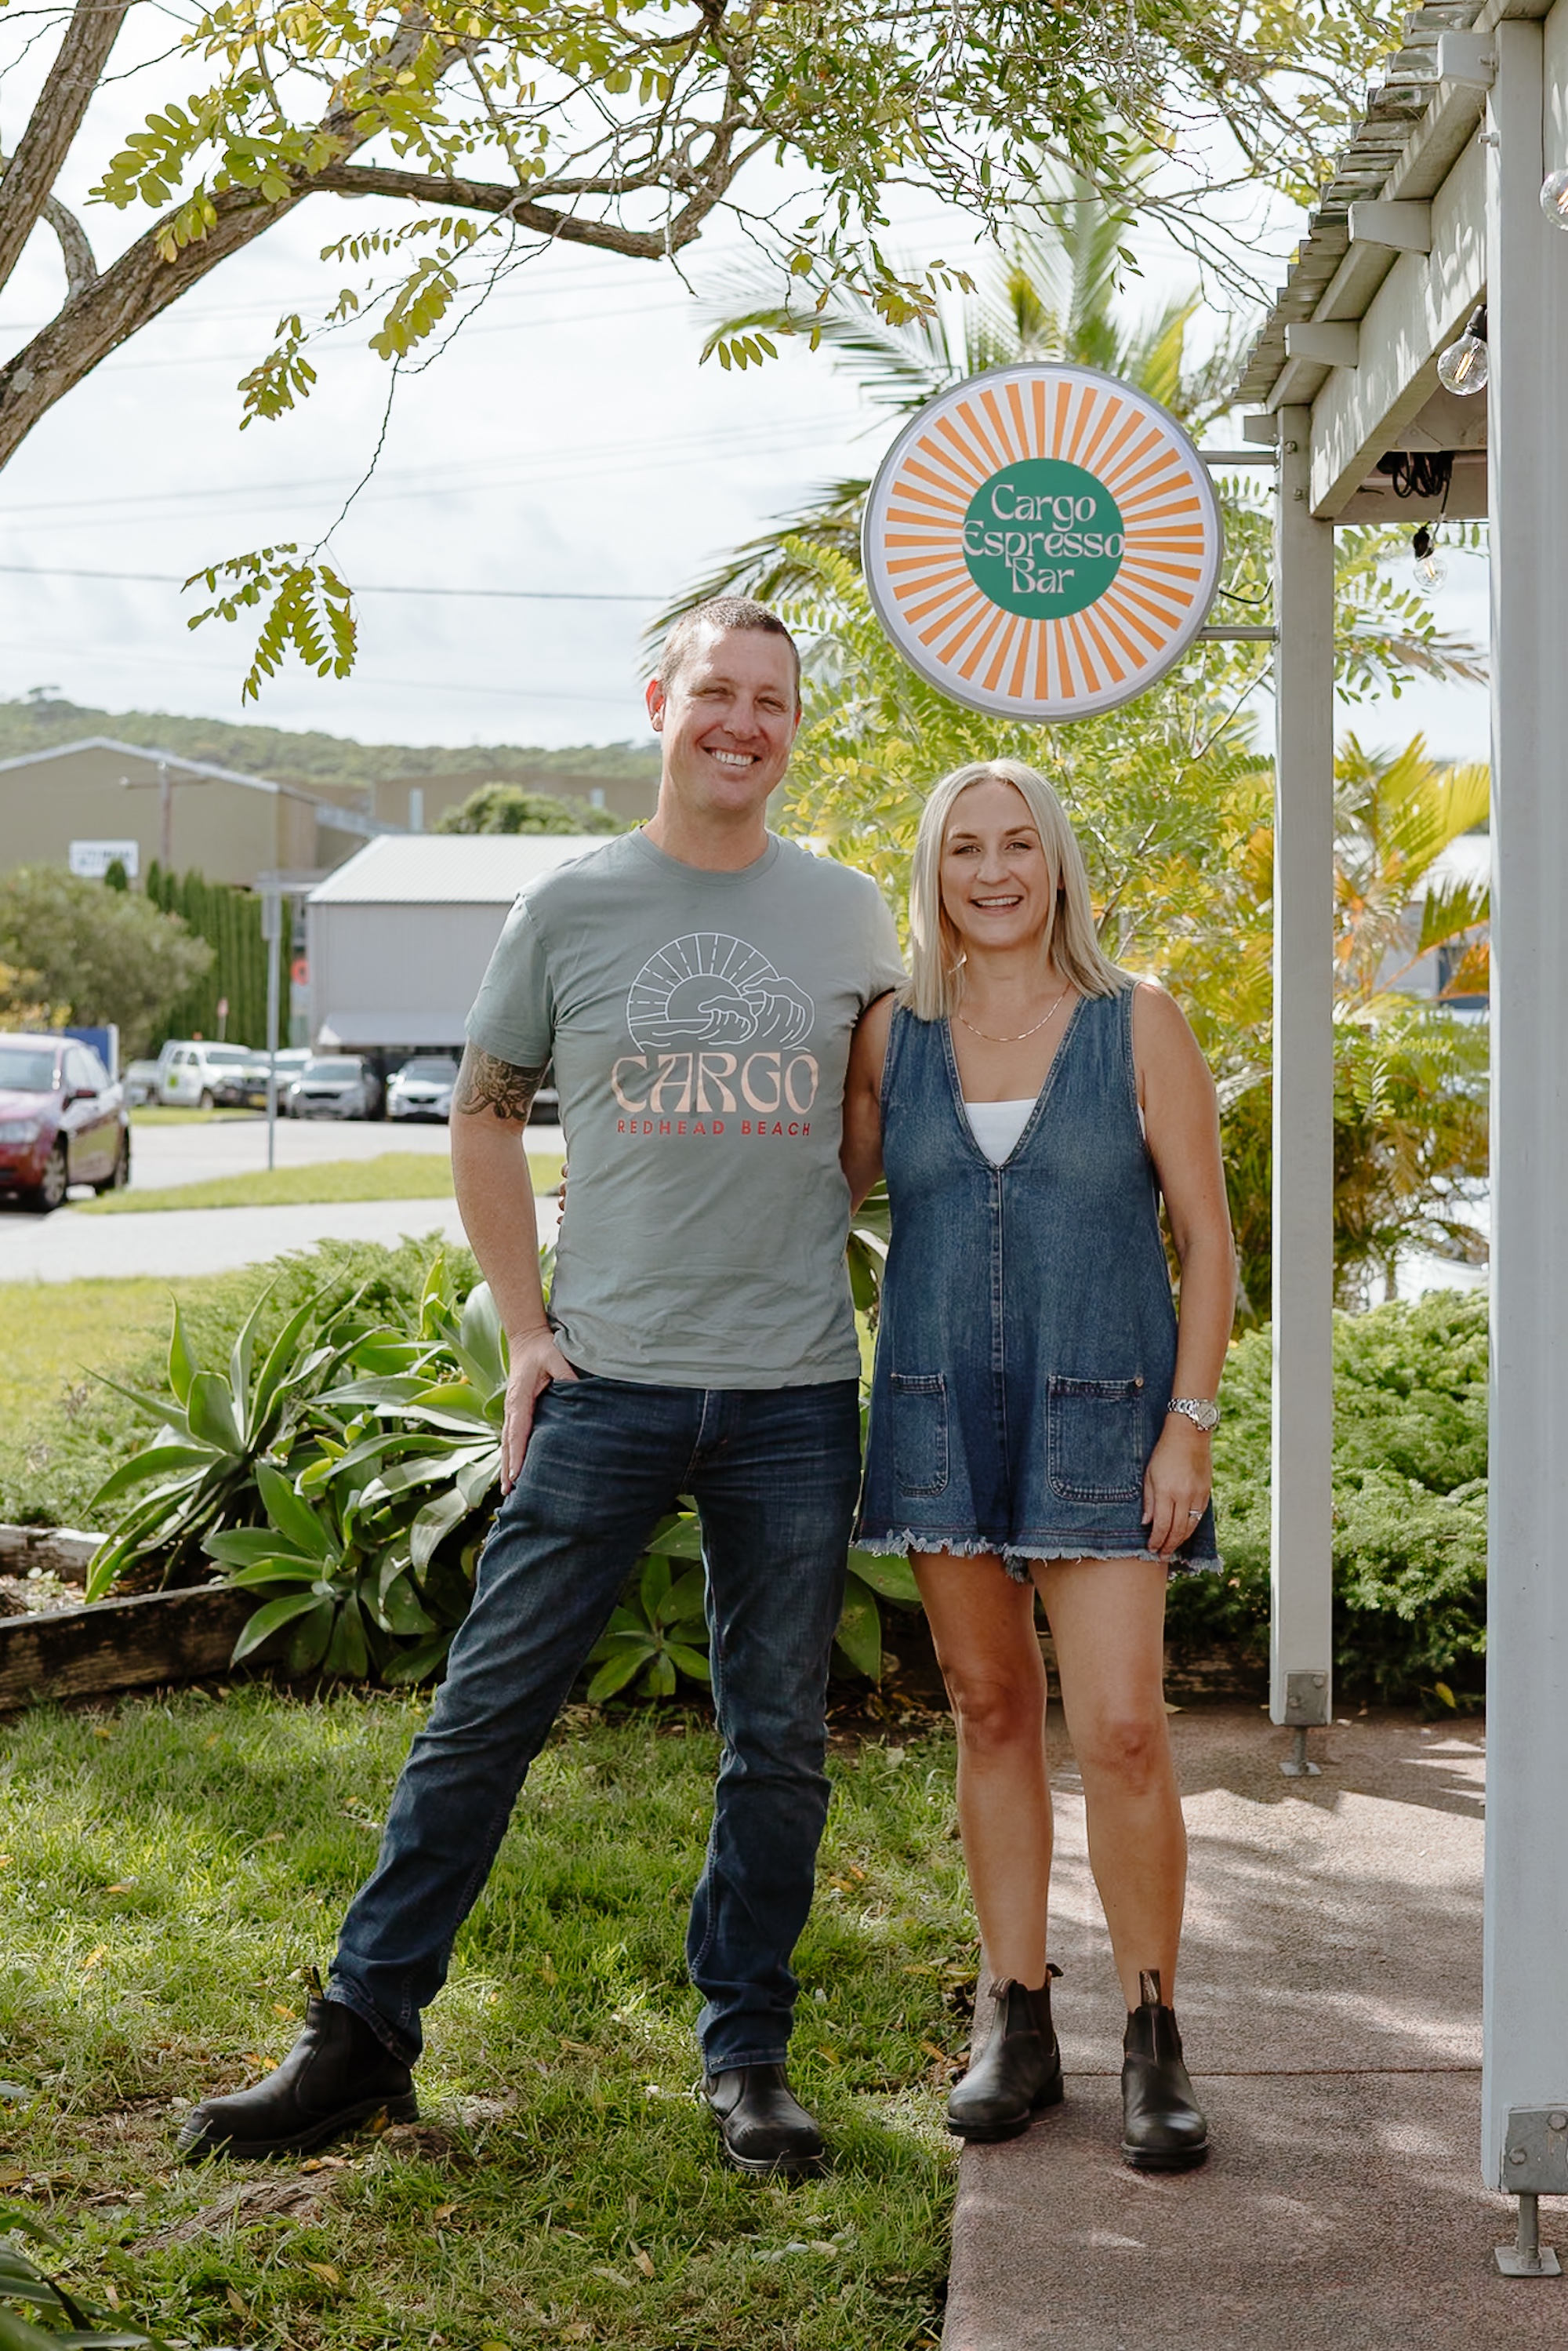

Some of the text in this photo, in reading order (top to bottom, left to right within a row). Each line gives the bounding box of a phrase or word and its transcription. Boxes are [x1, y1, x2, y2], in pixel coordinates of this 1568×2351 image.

[991, 484, 1097, 532] Cargo
[962, 520, 1126, 568] Espresso
[1011, 557, 1075, 594] Bar
[611, 1052, 819, 1114] CARGO
[617, 1120, 811, 1136] REDHEAD BEACH
